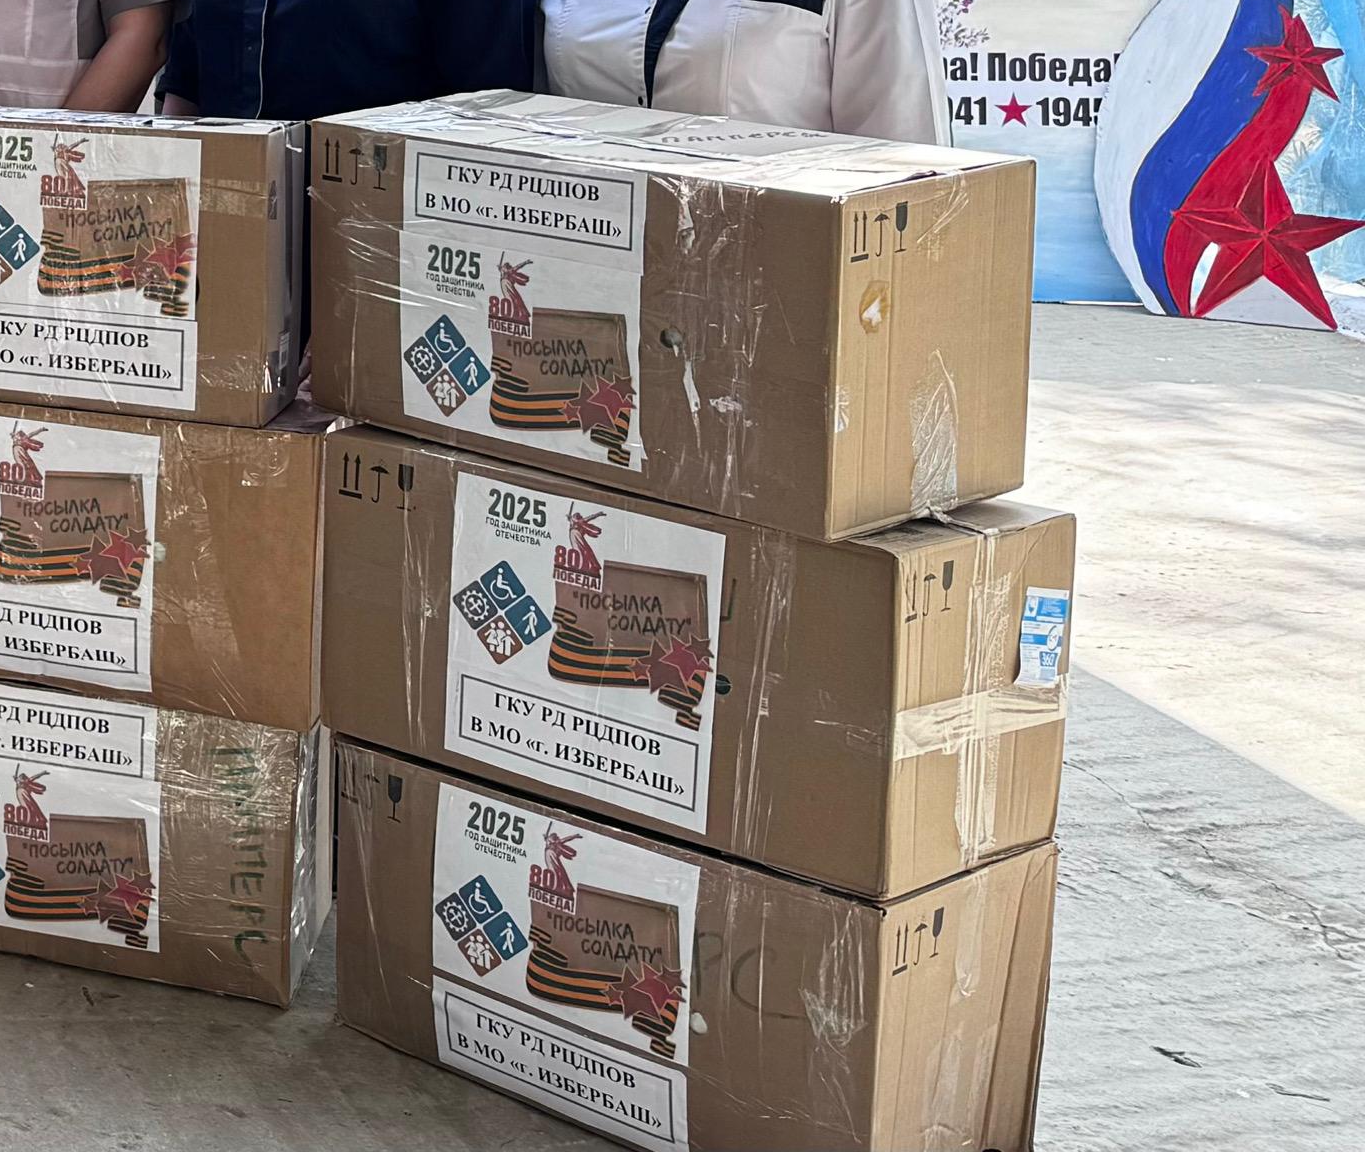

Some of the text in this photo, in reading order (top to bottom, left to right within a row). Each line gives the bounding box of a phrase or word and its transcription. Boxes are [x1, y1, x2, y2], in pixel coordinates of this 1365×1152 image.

[948, 97, 987, 125] 41
[447, 165, 599, 206] ГКУ РД РЦДПОВ
[425, 193, 622, 241] В МО «г. ИЗБЕРБАШ»
[427, 244, 480, 280] 2025
[34, 324, 58, 343] РД
[64, 326, 149, 352] РЦДПОВ
[20, 354, 42, 367] «г.
[50, 353, 172, 382] ИЗБЕРБАШ»
[487, 487, 548, 528] 2025
[484, 516, 551, 541] ГОД ЗАЩИТНИКА
[496, 529, 540, 547] ОТЕЧЕСТВА
[553, 568, 601, 590] ПОБЕДА!
[466, 800, 525, 846] 2025
